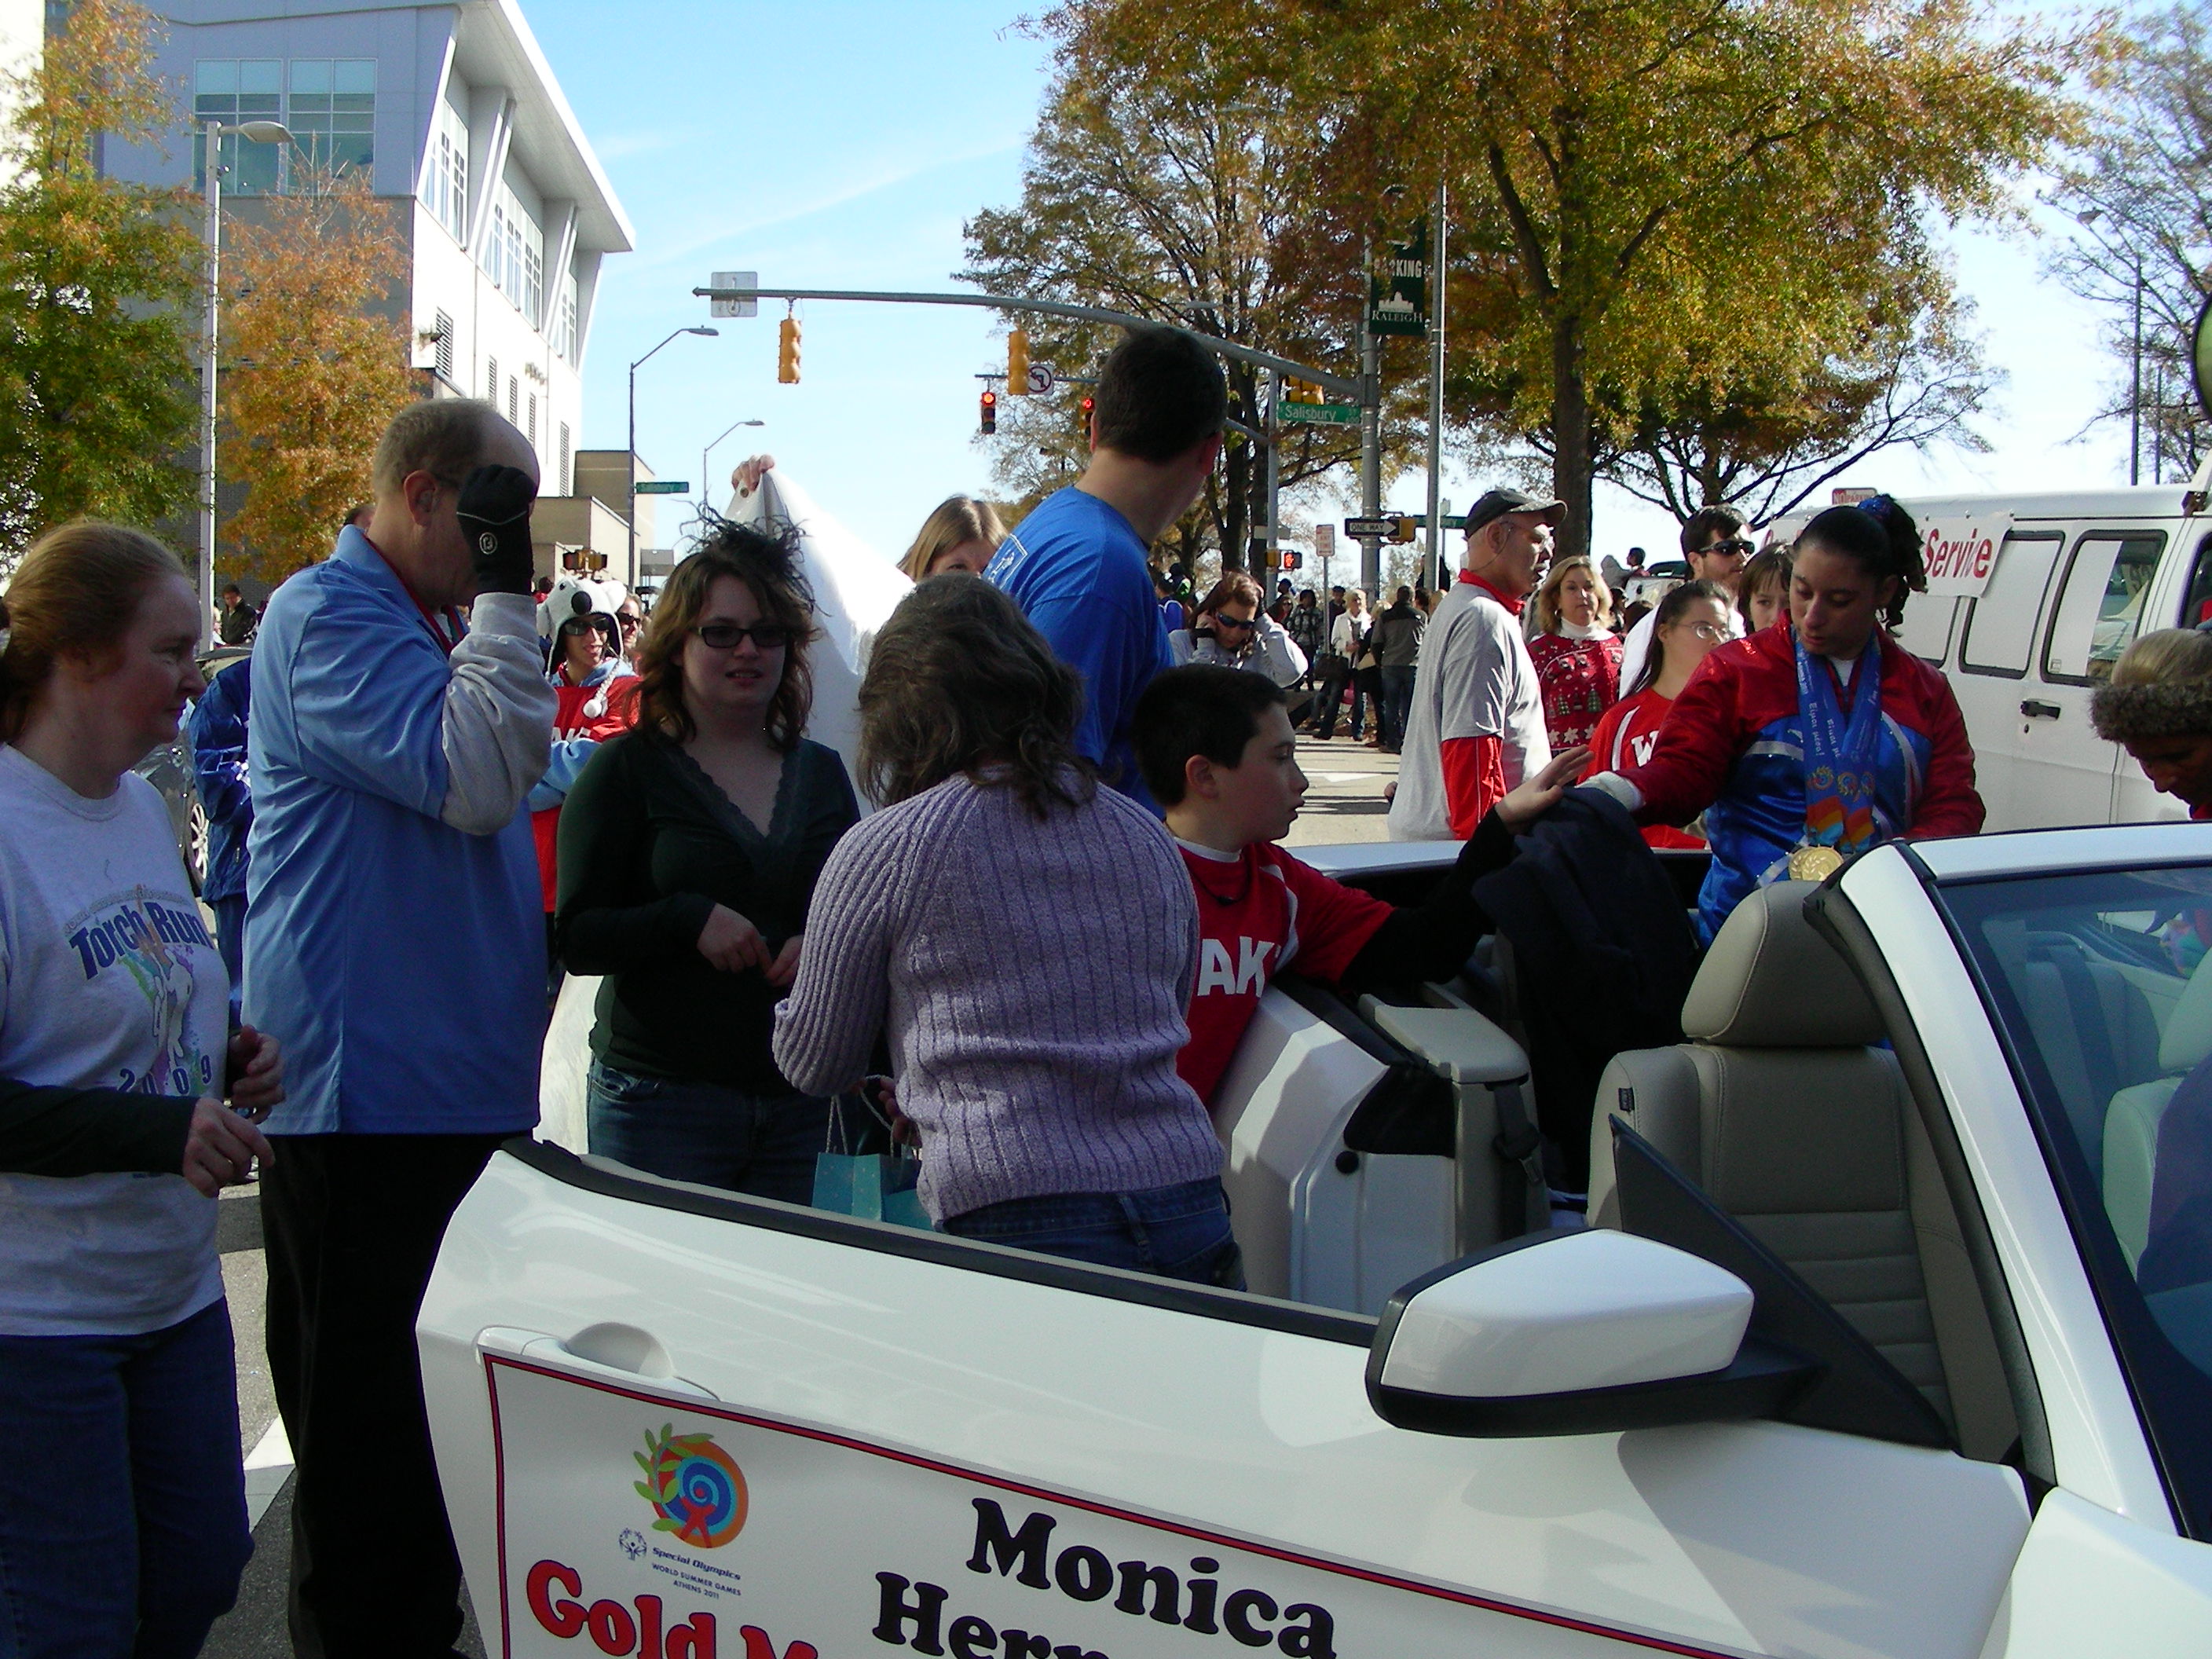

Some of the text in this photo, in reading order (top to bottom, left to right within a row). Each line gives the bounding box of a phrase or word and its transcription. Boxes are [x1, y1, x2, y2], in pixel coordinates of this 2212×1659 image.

[1372, 309, 1423, 322] RALEIGH
[1285, 405, 1336, 422] Salisbury
[1351, 522, 1383, 532] ONE WAY
[69, 905, 153, 980] Torch
[144, 903, 214, 950] Run
[1197, 936, 1281, 998] AK
[118, 1055, 211, 1094] 2009
[652, 1547, 741, 1580] Special Olympics
[652, 1562, 742, 1596] WORLD SUMMER GAMES
[966, 1498, 1337, 1659] Monica
[673, 1580, 720, 1599] ATHENS 2011
[526, 1559, 716, 1659] Gold
[873, 1572, 1109, 1659] Her
